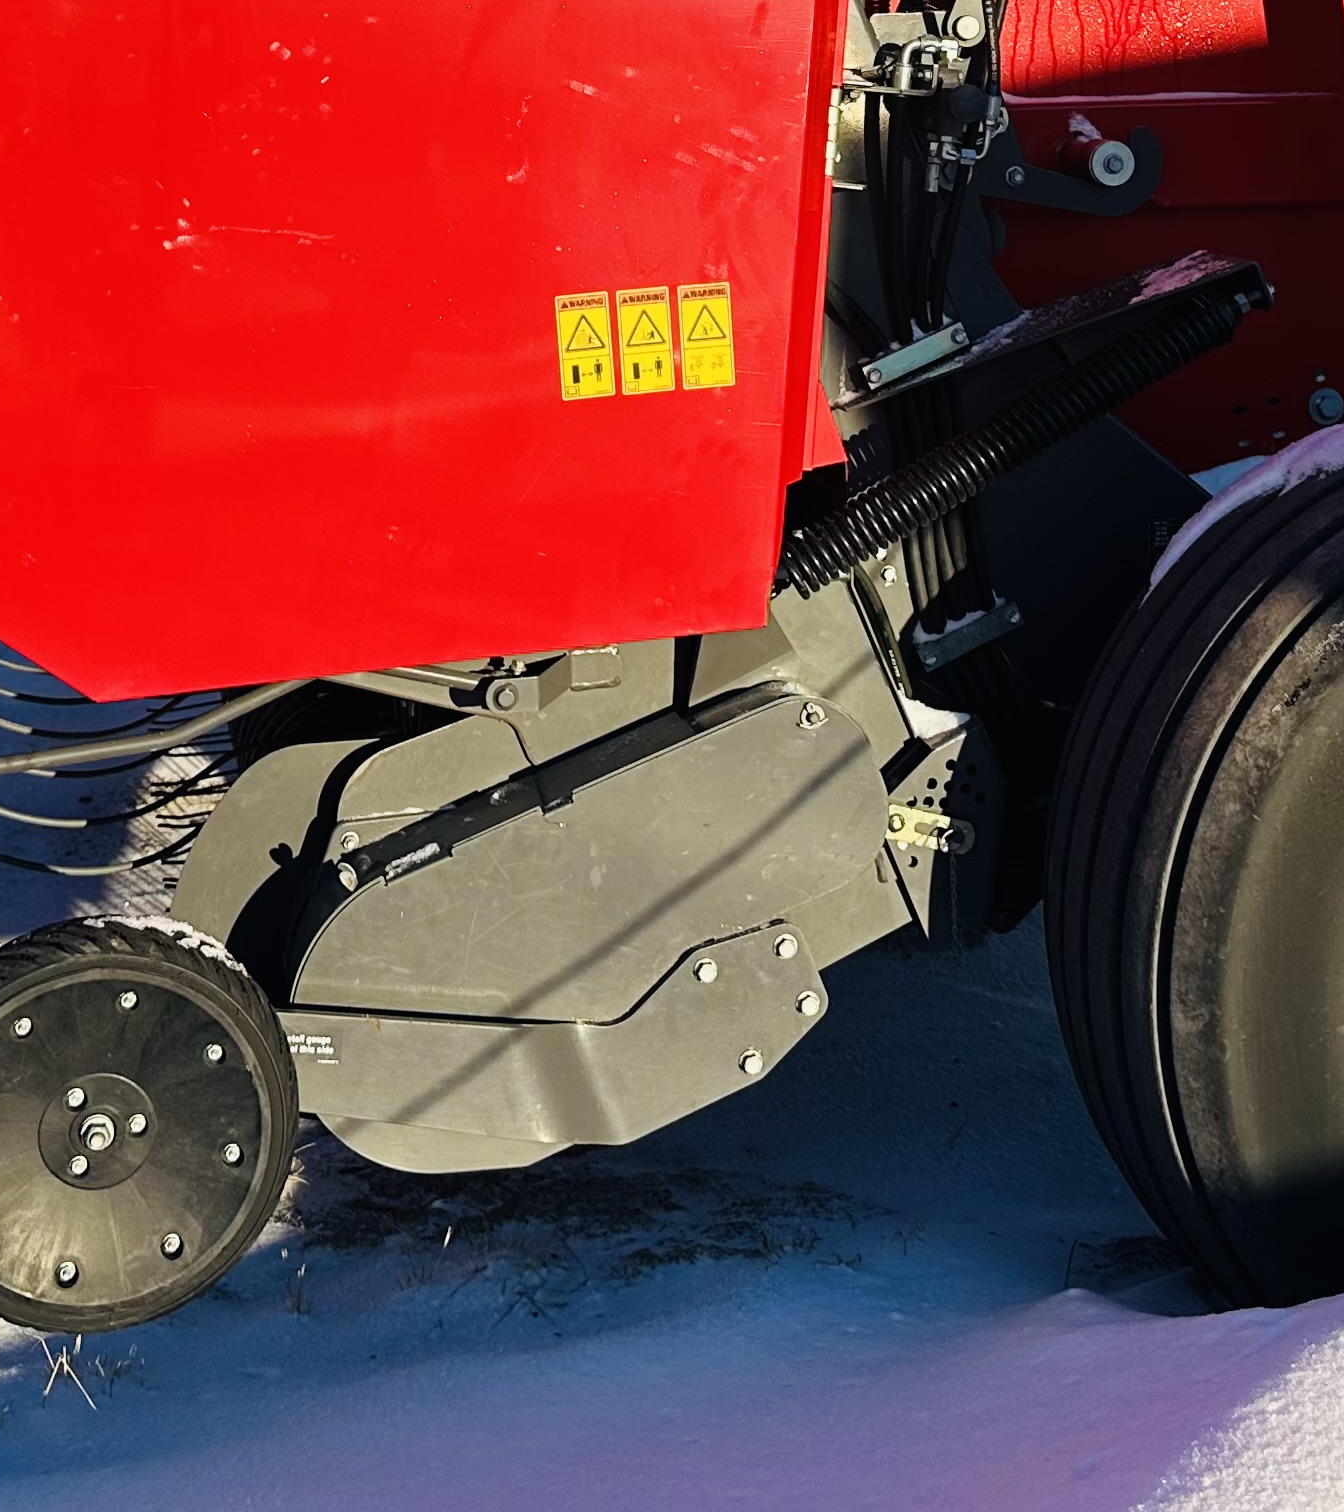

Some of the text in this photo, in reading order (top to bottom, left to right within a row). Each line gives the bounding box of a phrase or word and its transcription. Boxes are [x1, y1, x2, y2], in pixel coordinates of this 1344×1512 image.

[629, 292, 666, 304] WARNING
[689, 287, 728, 299] WARNING
[568, 297, 605, 309] WARNING
